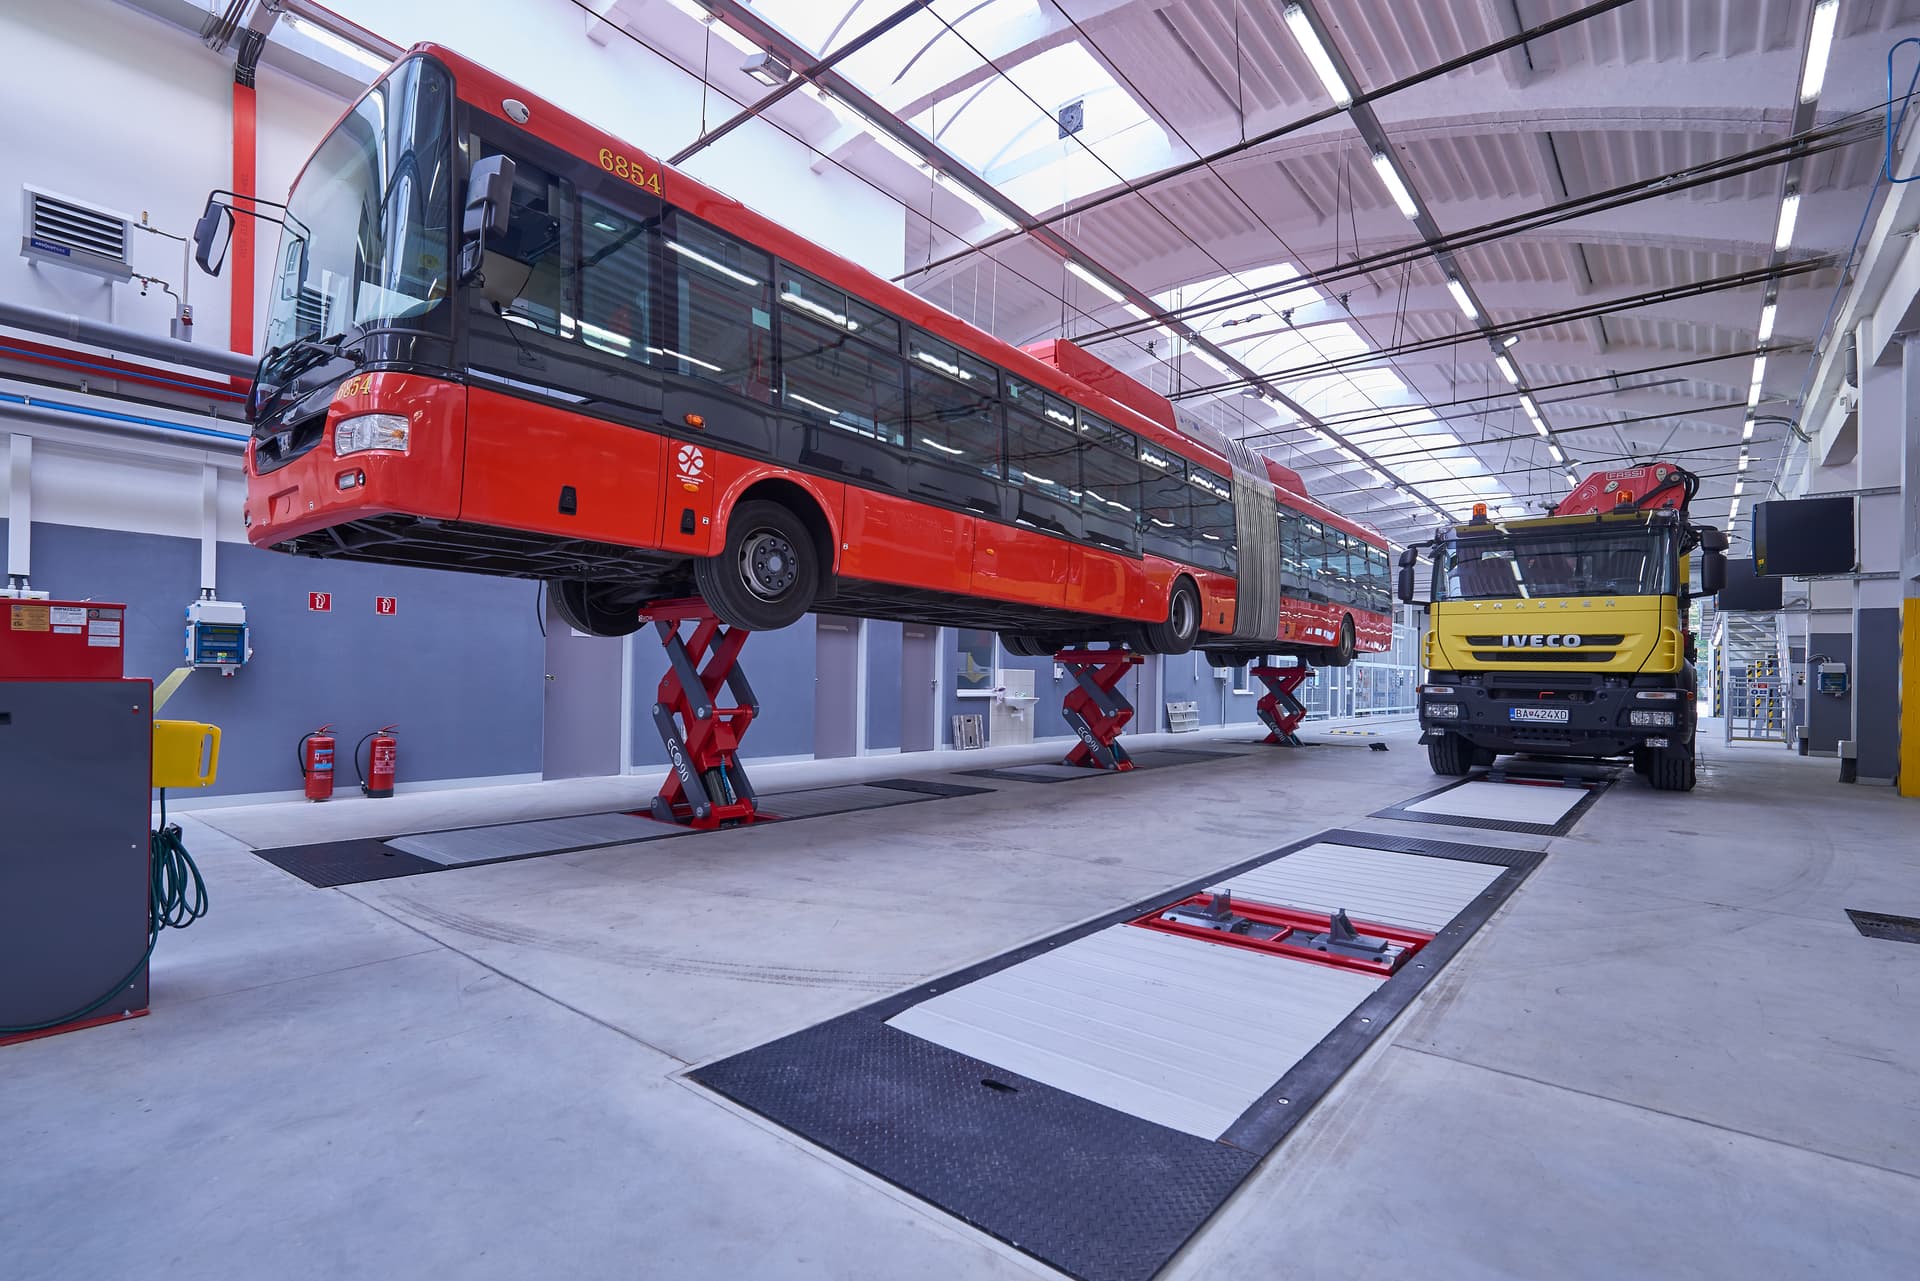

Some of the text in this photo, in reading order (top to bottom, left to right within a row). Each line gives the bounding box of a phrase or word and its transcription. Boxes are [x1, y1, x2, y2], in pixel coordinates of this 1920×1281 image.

[599, 148, 661, 195] 6854
[336, 376, 372, 400] 6854
[1608, 470, 1643, 479] FASSI
[1502, 634, 1581, 648] IVECO
[1078, 726, 1100, 752] ECO90
[667, 738, 689, 782] ECO90
